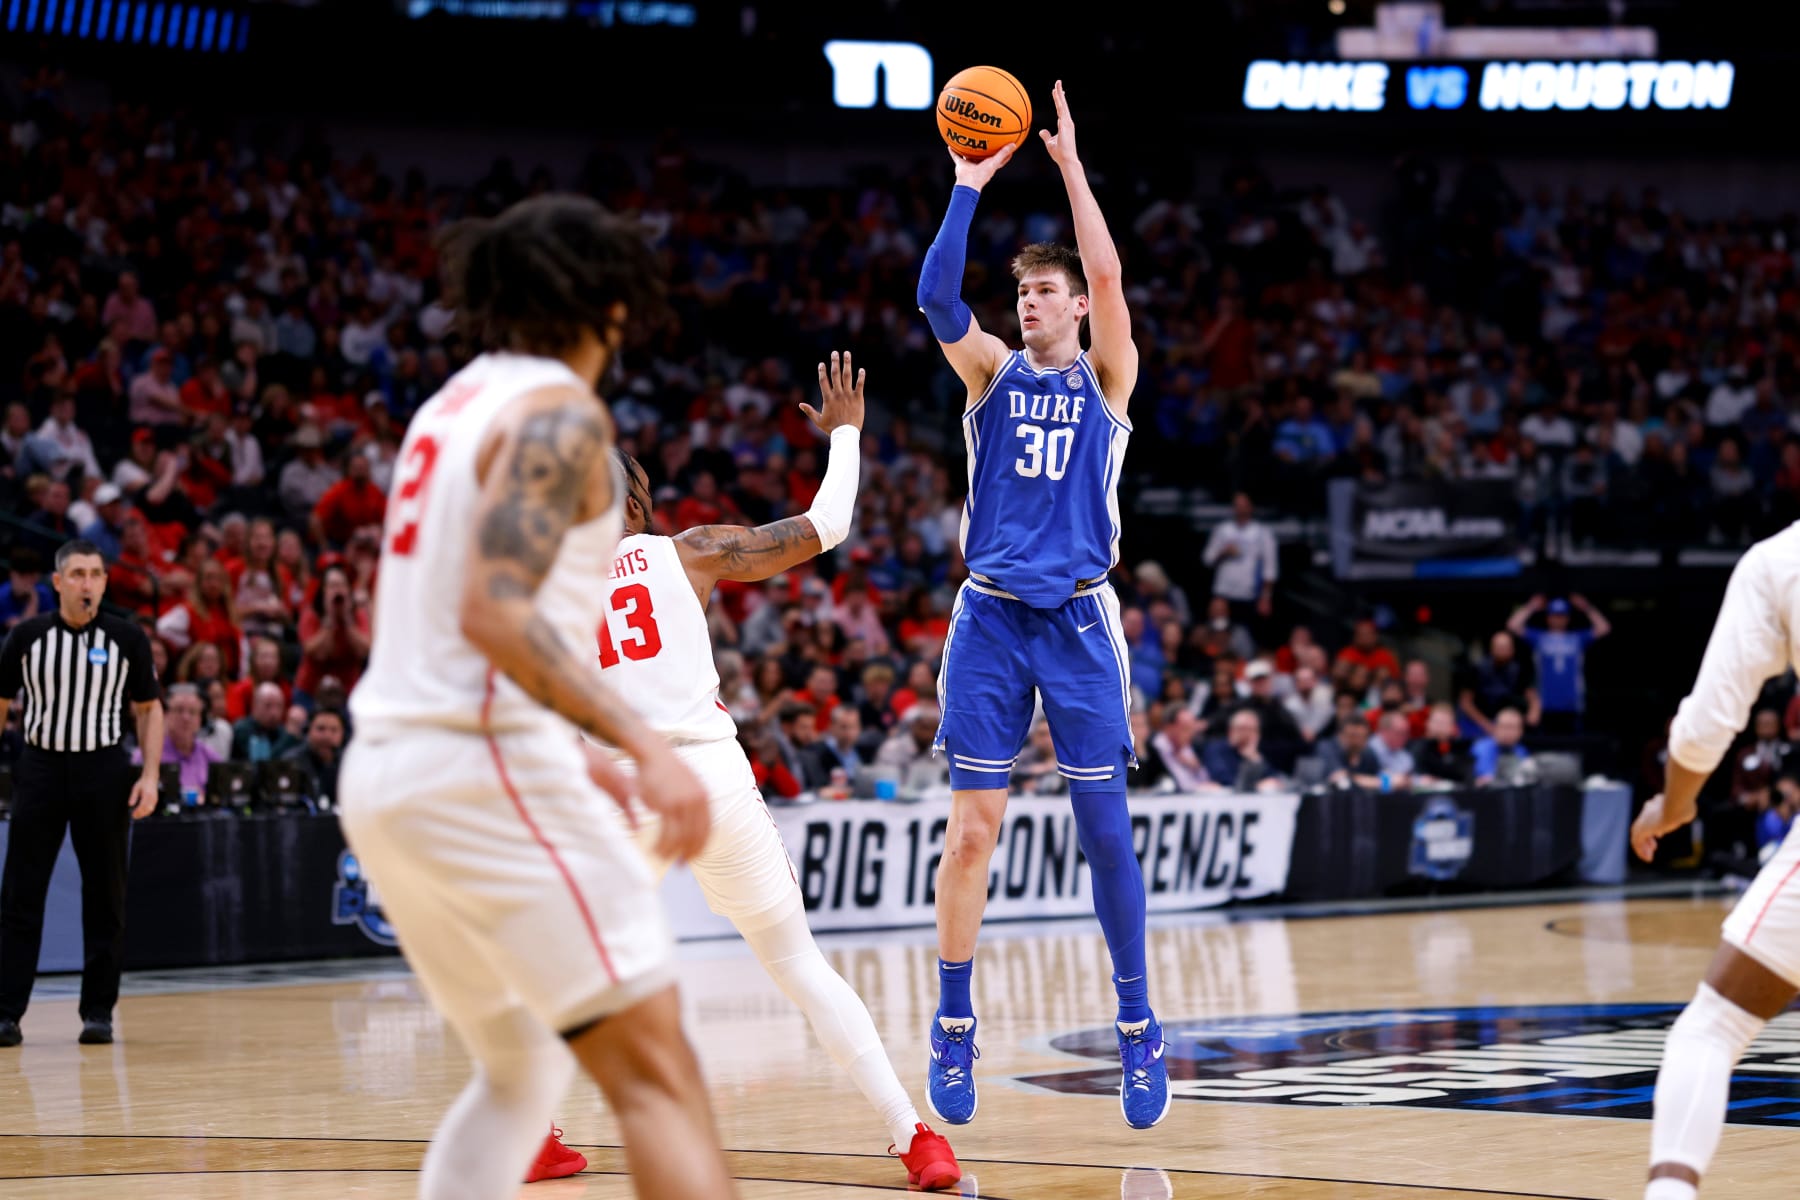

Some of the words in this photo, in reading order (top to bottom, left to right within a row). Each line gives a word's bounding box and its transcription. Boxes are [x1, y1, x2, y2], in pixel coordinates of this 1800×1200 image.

[1245, 60, 1389, 110] DUKE
[1406, 66, 1468, 109] VS
[1479, 60, 1734, 110] HOUSTON
[944, 95, 1002, 128] Wilson
[946, 128, 988, 150] NCAA
[1009, 391, 1085, 424] DUKE
[1015, 423, 1075, 481] 30
[597, 583, 662, 670] 13
[802, 820, 887, 912] BIG
